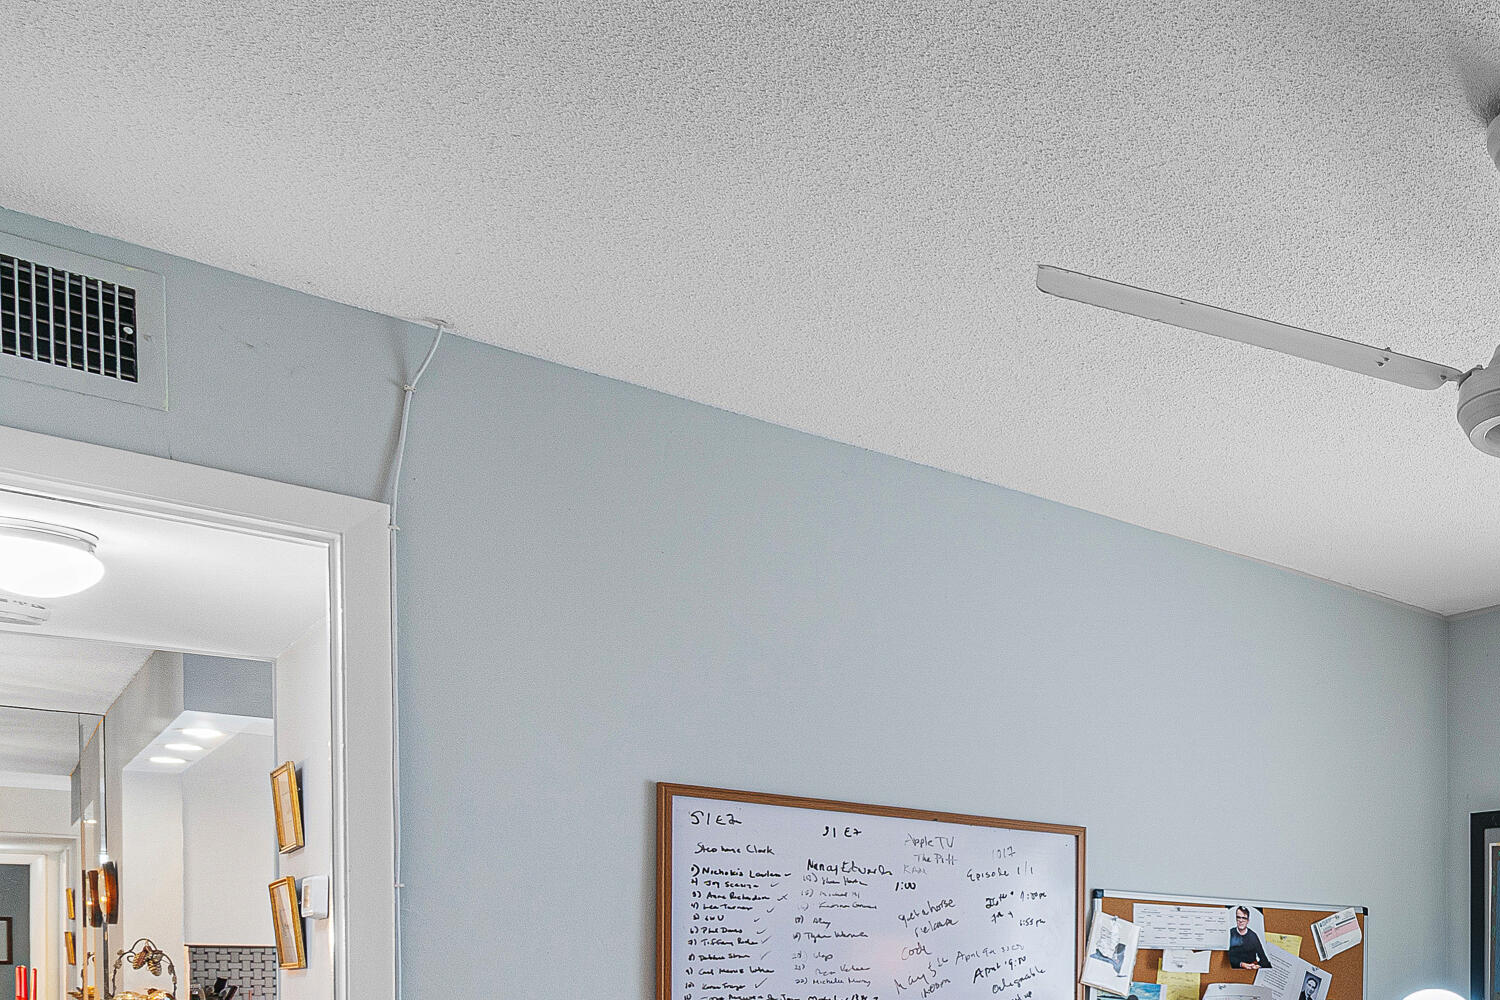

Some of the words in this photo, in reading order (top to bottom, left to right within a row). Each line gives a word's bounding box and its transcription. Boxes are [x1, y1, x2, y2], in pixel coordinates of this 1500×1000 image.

[904, 832, 934, 849] Apple
[935, 836, 955, 849] TV
[913, 853, 932, 864] The
